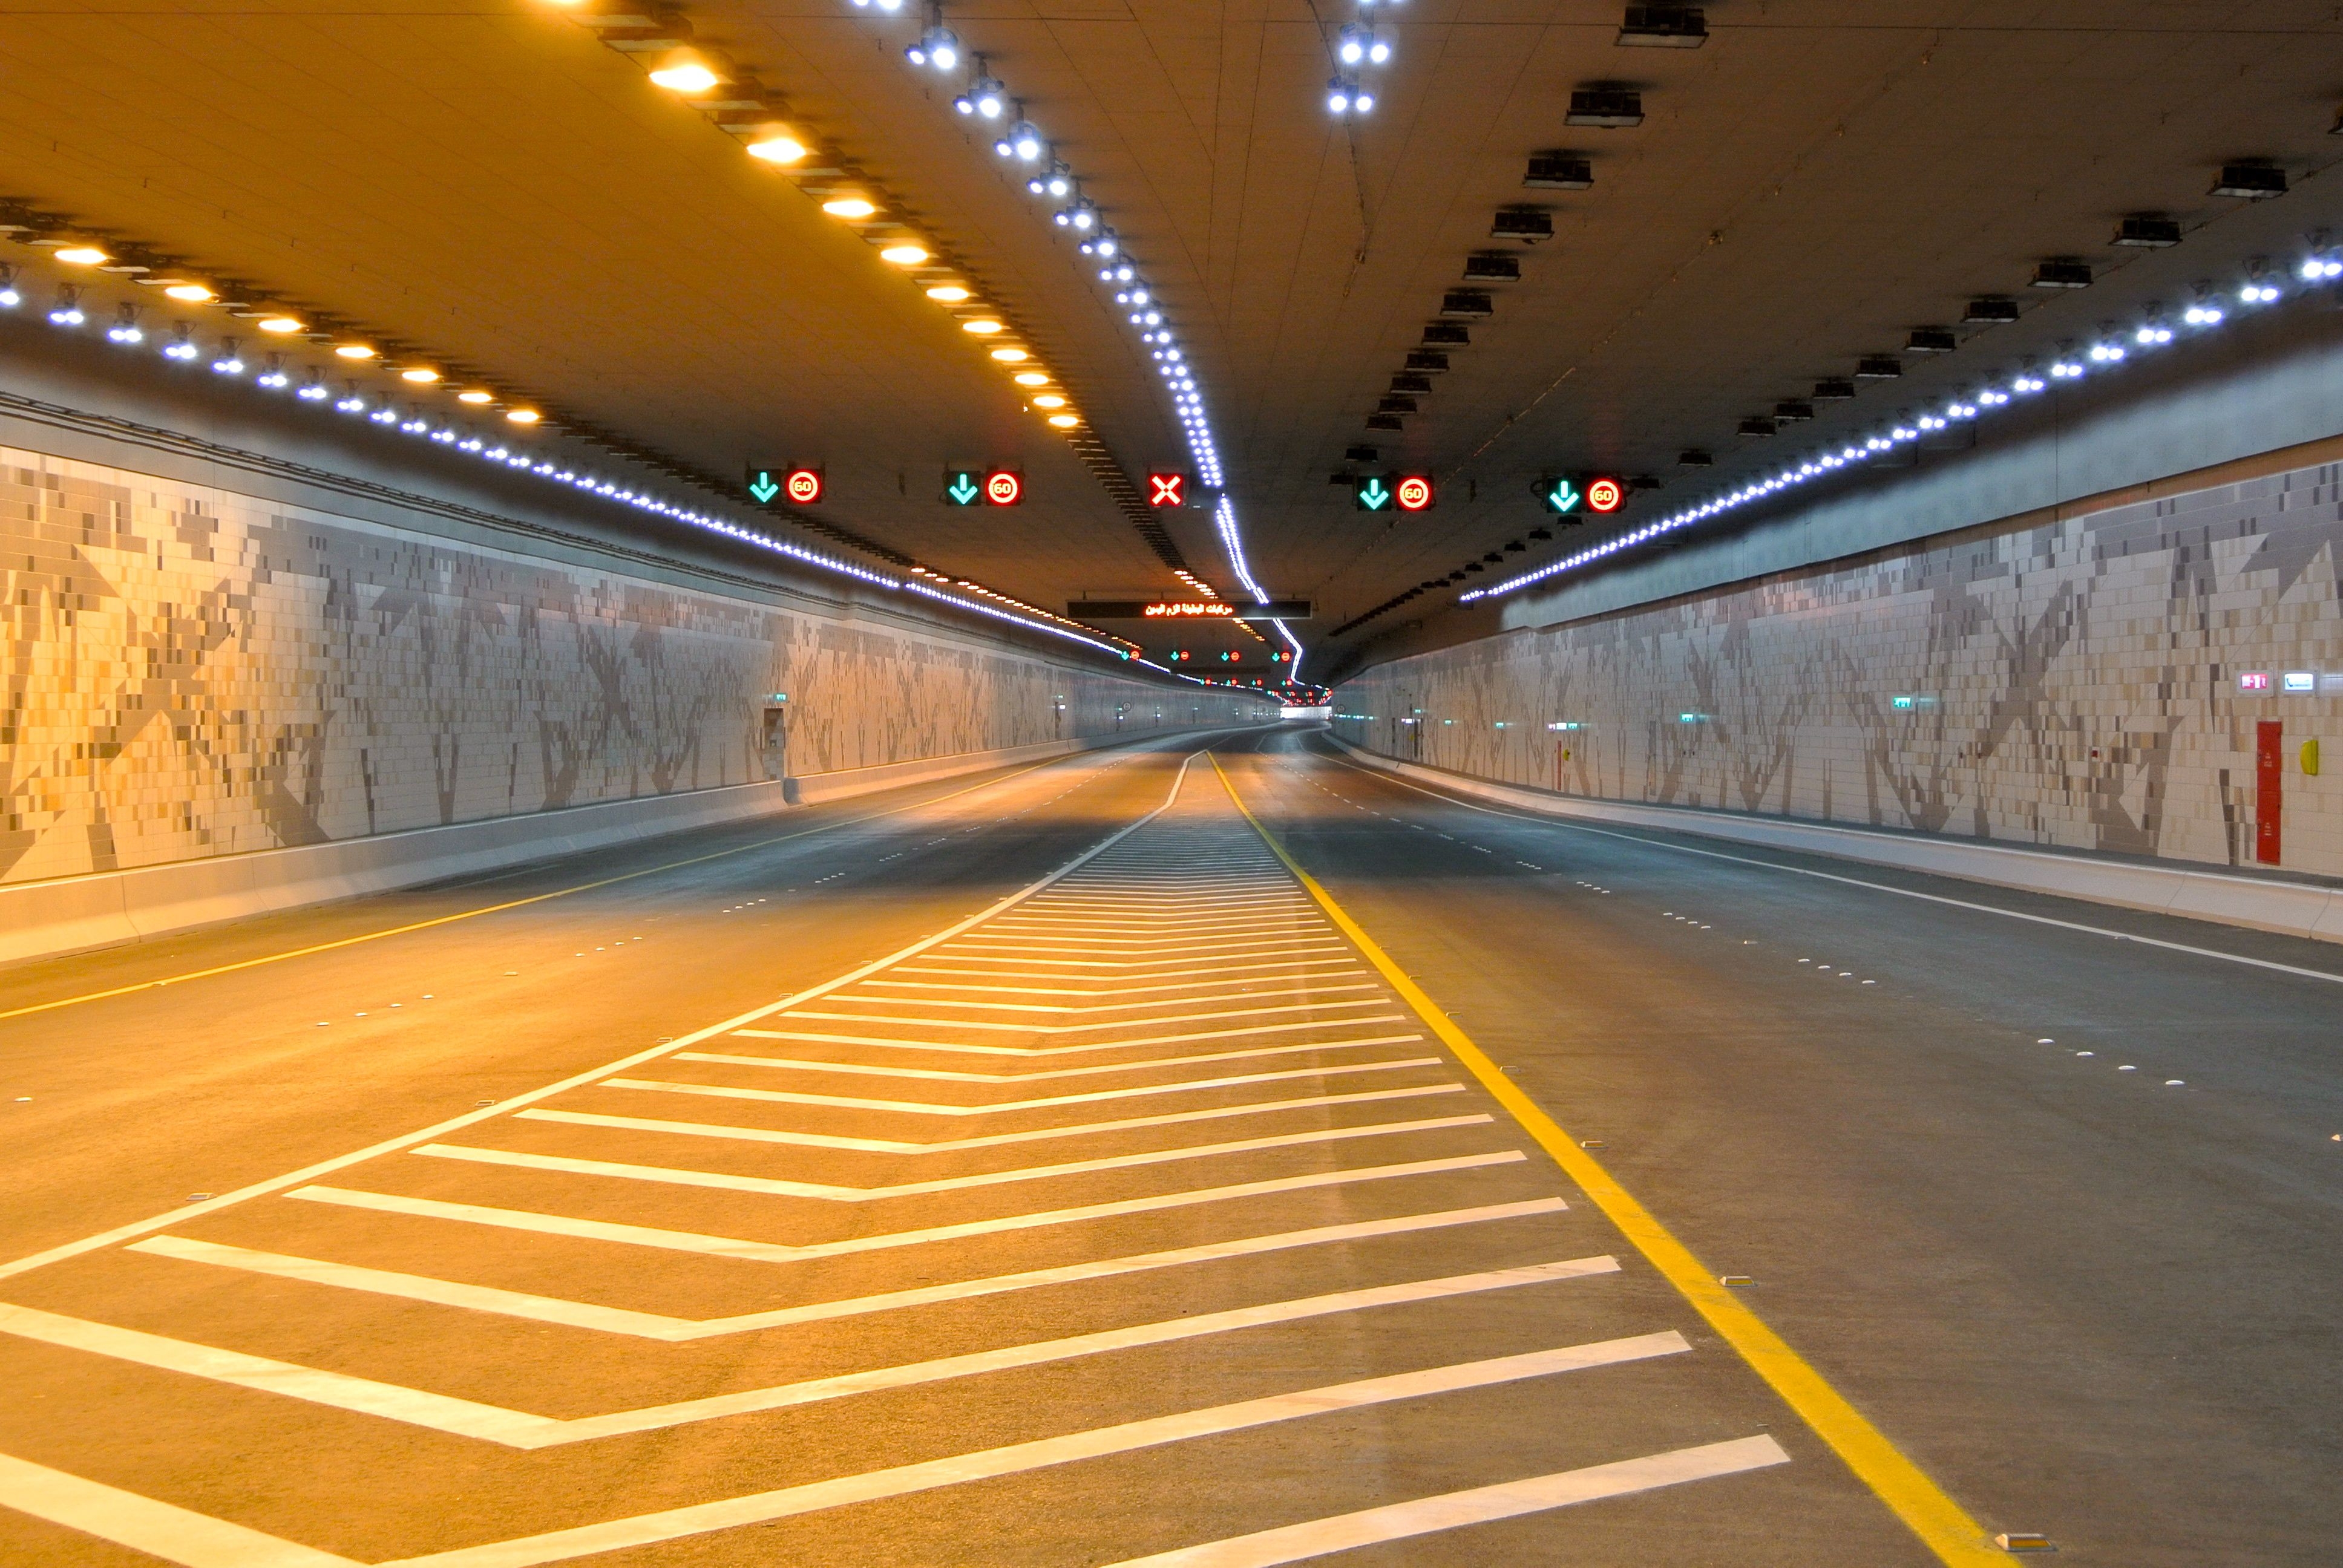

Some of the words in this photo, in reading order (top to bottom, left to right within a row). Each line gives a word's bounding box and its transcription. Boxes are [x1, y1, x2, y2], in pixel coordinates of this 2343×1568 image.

[795, 481, 811, 492] 60
[994, 483, 1011, 494] 60
[1405, 488, 1422, 499] 60
[1595, 490, 1613, 501] 60
